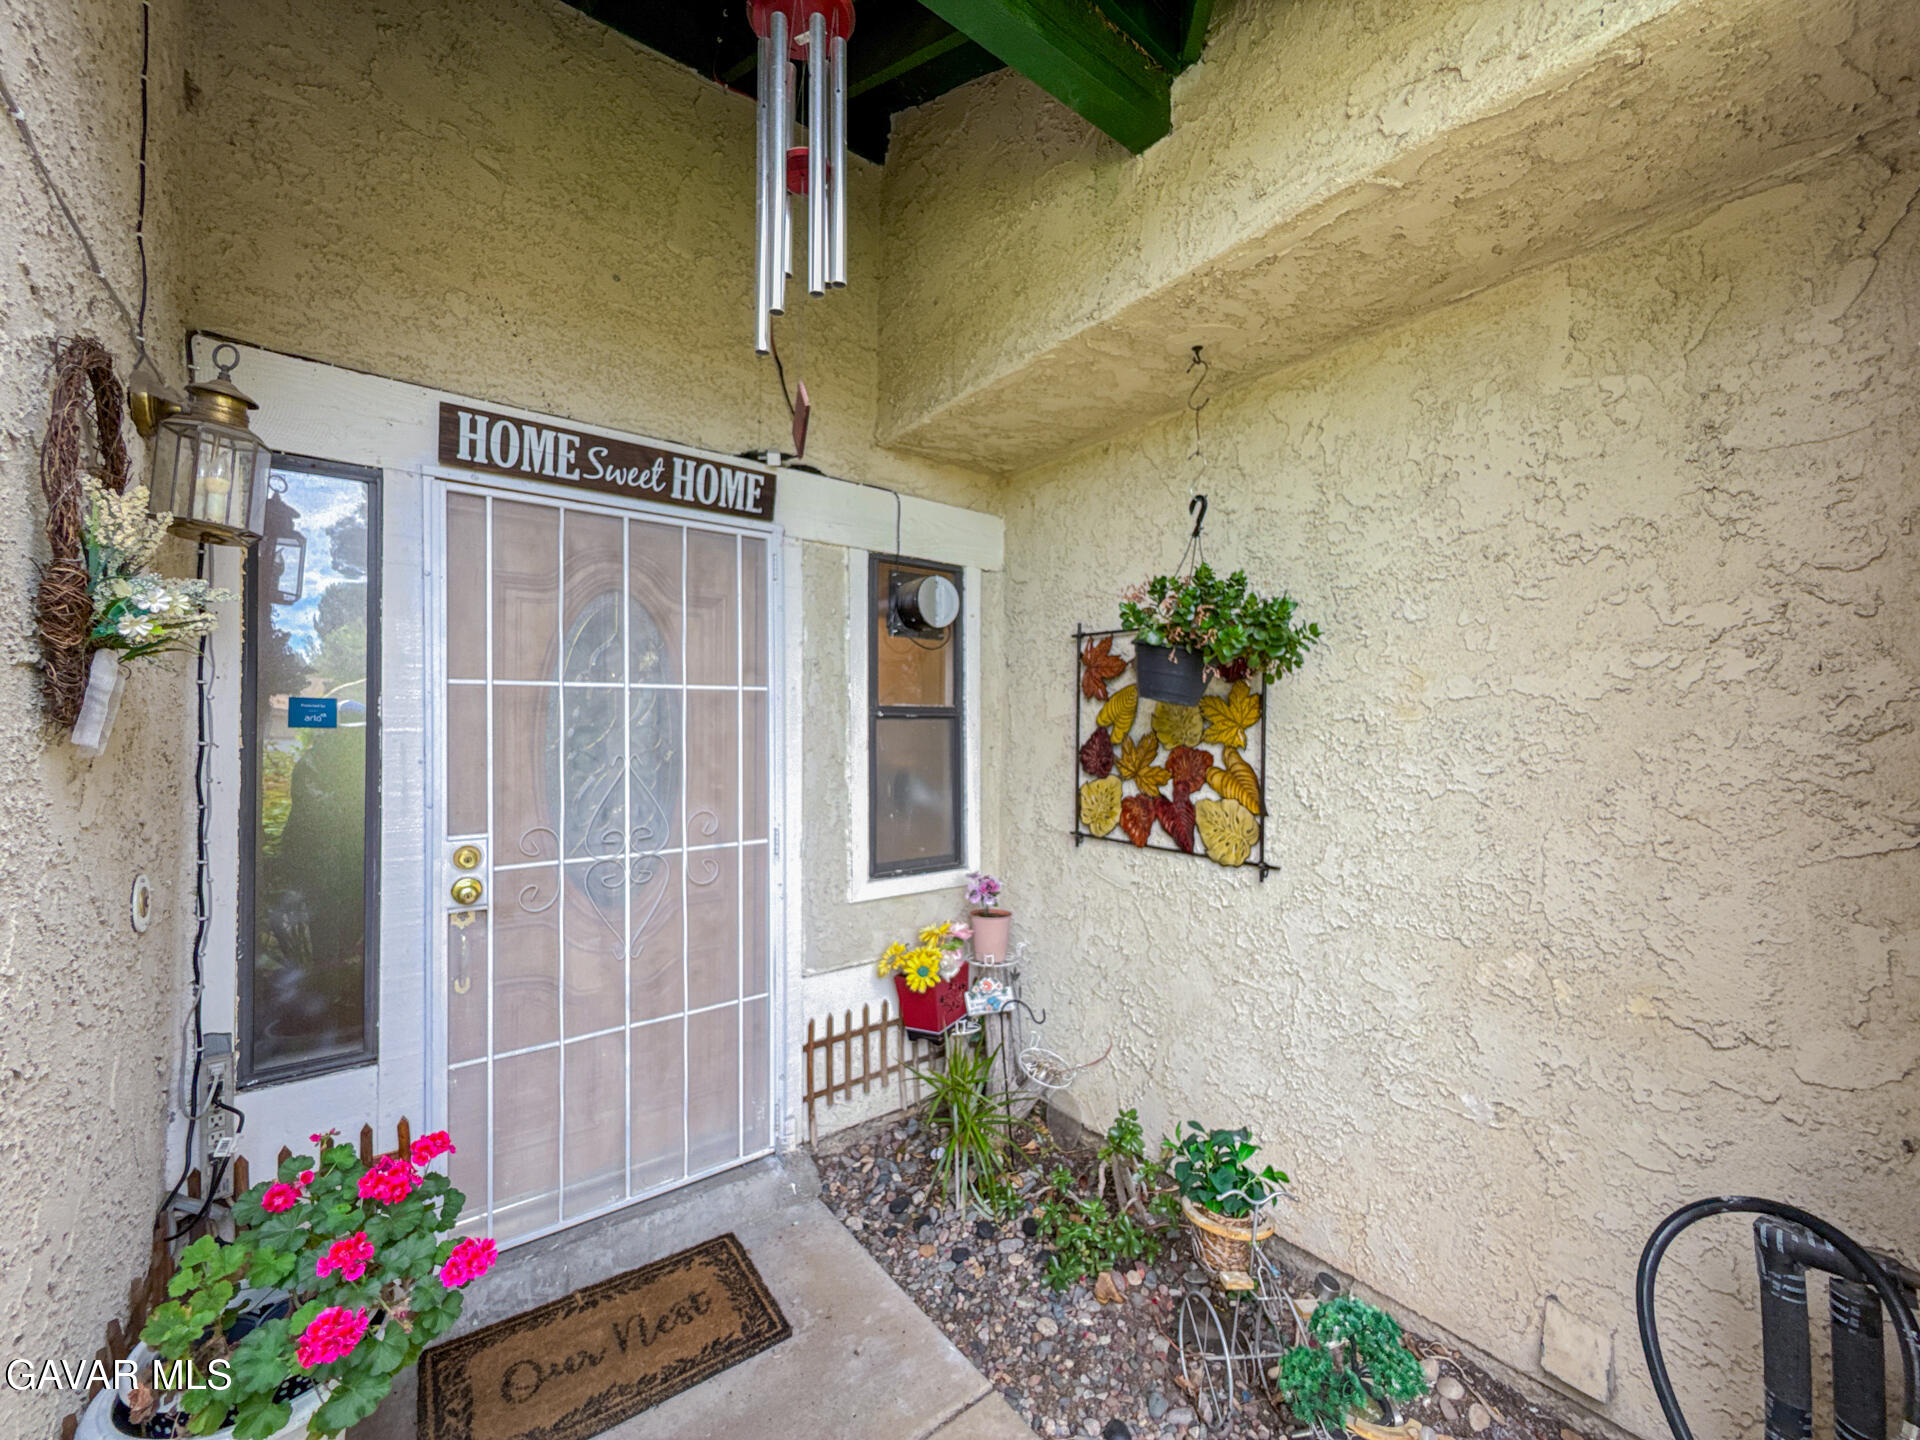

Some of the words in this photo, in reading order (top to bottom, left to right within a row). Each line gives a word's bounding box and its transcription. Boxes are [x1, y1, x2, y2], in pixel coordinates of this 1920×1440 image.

[456, 411, 581, 481] HOME
[582, 446, 667, 493] Sweet
[670, 457, 765, 514] HOME
[304, 714, 322, 722] arlo
[611, 1290, 712, 1356] Nest
